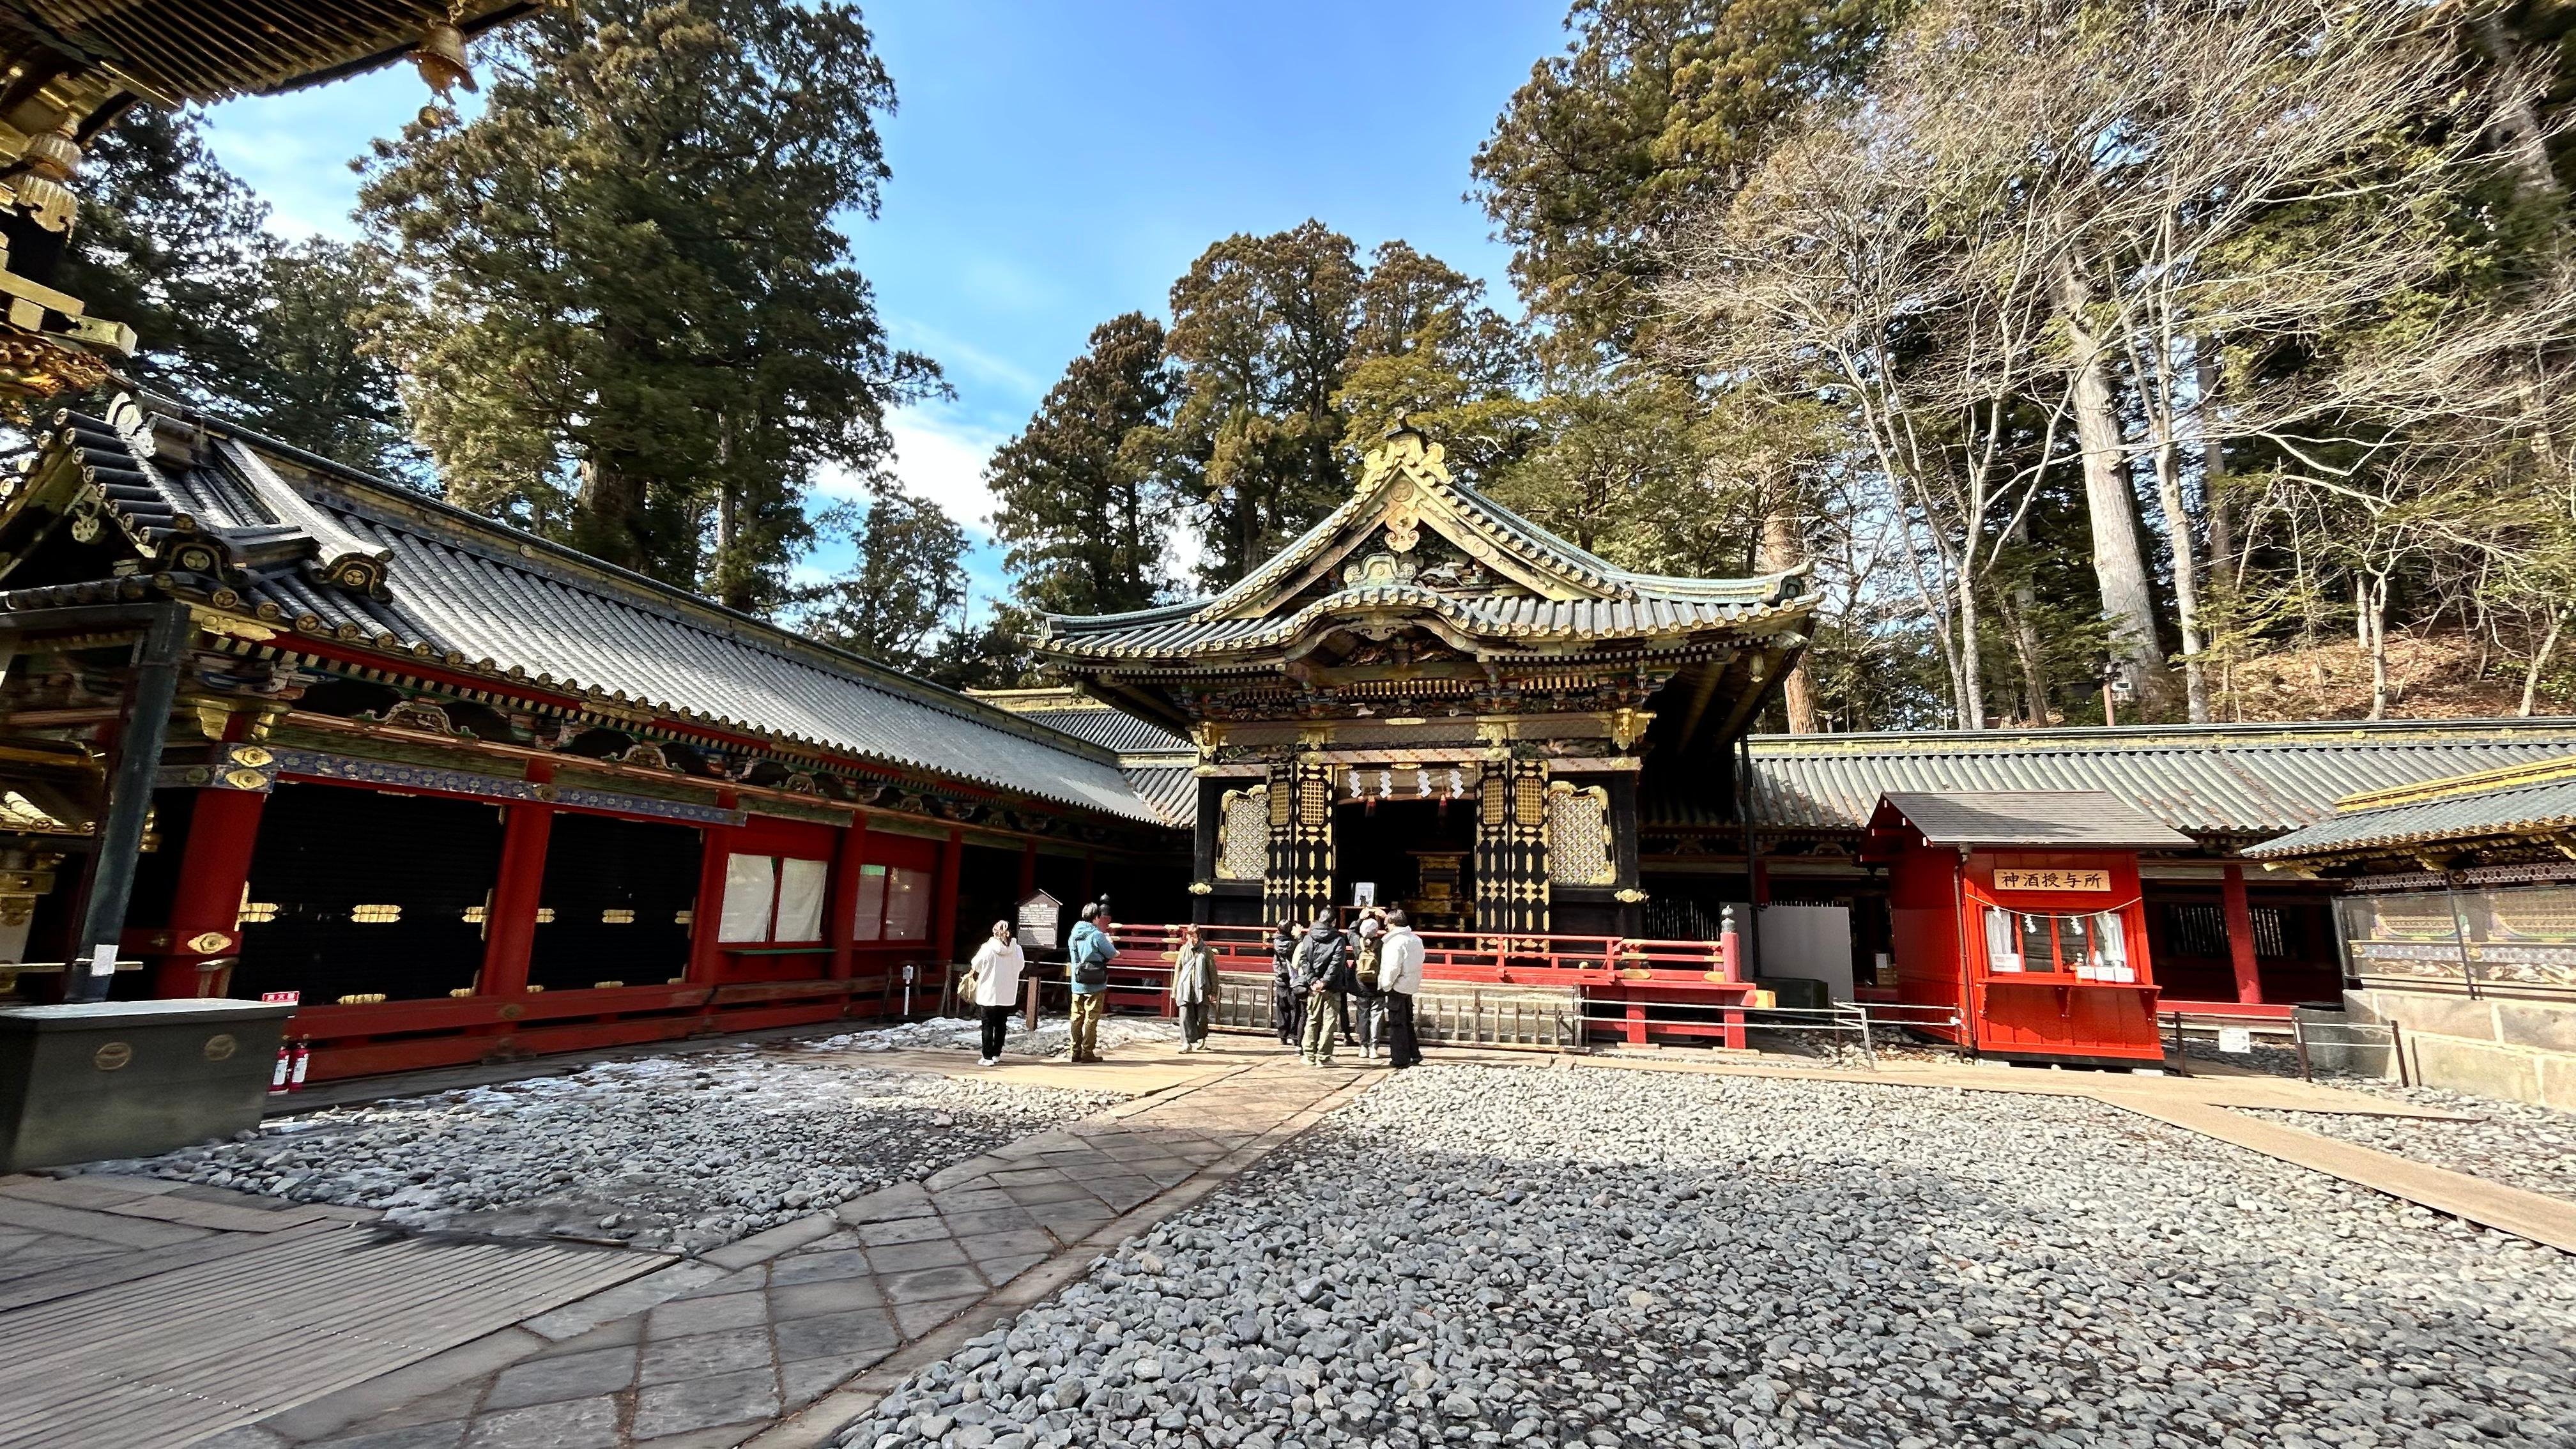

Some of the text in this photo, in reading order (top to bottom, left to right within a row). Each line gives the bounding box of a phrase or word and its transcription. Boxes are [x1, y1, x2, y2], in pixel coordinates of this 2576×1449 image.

[2002, 872, 2102, 889] 神酒授与所
